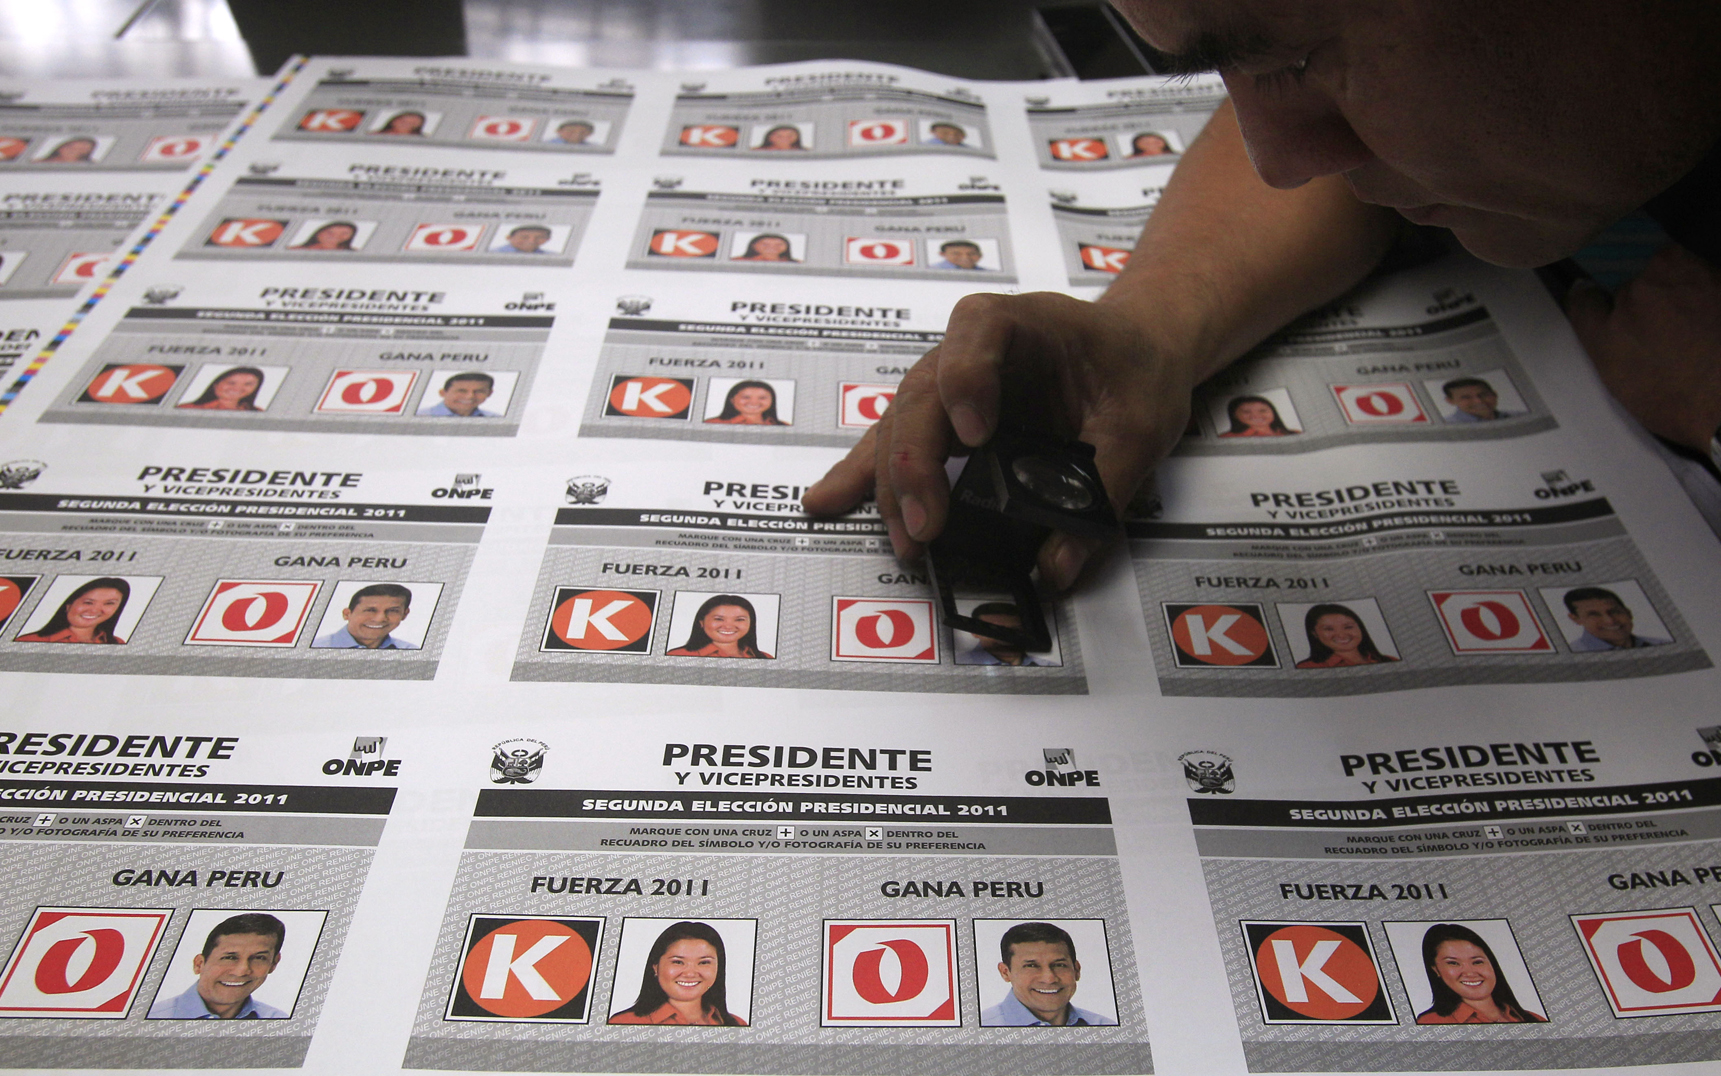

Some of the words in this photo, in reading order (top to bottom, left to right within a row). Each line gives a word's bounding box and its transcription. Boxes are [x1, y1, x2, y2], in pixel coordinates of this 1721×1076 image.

[310, 112, 356, 130] K
[689, 128, 727, 146] K
[1058, 140, 1097, 158] K
[219, 221, 271, 243] K
[660, 233, 706, 253] K
[1089, 246, 1130, 268] K
[259, 287, 446, 303] PRESIDENTE
[505, 302, 556, 311] ONPE
[731, 301, 911, 320] PRESIDENTE
[148, 345, 221, 355] FUERZA
[228, 346, 266, 356] 2011
[379, 352, 434, 361] GANA
[439, 353, 489, 362] PERU
[649, 356, 721, 368] FUERZA
[727, 360, 764, 369] 2011
[1414, 359, 1461, 374] PERU
[96, 370, 165, 398] K
[622, 381, 677, 412] K
[137, 466, 363, 488] PRESIDENTE
[143, 484, 156, 493] Y
[163, 485, 342, 499] VICEPRESIDENTES
[431, 487, 494, 500] ONPE
[703, 481, 810, 500] PRESI
[1250, 479, 1461, 508] PRESIDENTE
[1534, 480, 1596, 500] ONPE
[57, 499, 141, 511] SEGUNDA
[146, 501, 231, 514] ELECCIÓN
[234, 504, 358, 517] PRESIDENCIAL
[363, 508, 406, 518] 2011
[713, 499, 725, 508] Y
[1267, 510, 1279, 519] Y
[1285, 498, 1455, 519] VICEPRESIDENTES
[639, 513, 721, 526] SEGUNDA
[727, 517, 808, 530] ELECCIÓN
[1206, 527, 1285, 537] SEGUNDA
[1289, 521, 1369, 537] ELECCIÓN
[1372, 514, 1488, 528] PRESIDENCIAL
[1491, 513, 1532, 523] 2011
[655, 539, 709, 548] RECUADRO
[678, 532, 720, 541] MARQUE
[87, 551, 138, 562] 2011
[274, 556, 340, 567] GANA
[347, 557, 409, 569] PERU
[601, 562, 690, 577] FUERZA
[697, 567, 742, 579] 2011
[1459, 564, 1523, 576] GANA
[1527, 560, 1583, 575] PERU
[877, 573, 935, 585] GAN
[1195, 576, 1281, 589] FUERZA
[1285, 577, 1329, 589] 2011
[566, 598, 635, 641] K
[1185, 615, 1254, 655] K
[662, 743, 932, 772] PRESIDENTE
[1340, 740, 1601, 777] PRESIDENTE
[322, 759, 402, 777] ONPE
[675, 772, 691, 785] Y
[699, 772, 918, 789] VICEPRESIDENTES
[1025, 770, 1100, 787] ONPE
[1362, 781, 1377, 794] Y
[1385, 768, 1595, 792] VICEPRESIDENTES
[70, 789, 227, 804] PRESIDENCIAL
[233, 793, 288, 805] 2011
[1289, 808, 1387, 821] SEGUNDA
[1391, 799, 1490, 818] ELECCIÓN
[1494, 794, 1639, 812] PRESIDENCIAL
[1642, 789, 1694, 804] 2011
[582, 799, 684, 812] SEGUNDA
[691, 798, 794, 813] ELECCIÓN
[800, 802, 951, 816] PRESIDENCIAL
[957, 805, 1008, 816] 2011
[0, 816, 32, 824] CRUZ
[58, 817, 68, 825] O
[72, 817, 90, 825] UN
[92, 817, 123, 825] ASPA
[148, 818, 197, 827] DENTRO
[9, 827, 33, 836] Y/O
[36, 828, 119, 837] FOTOGRAFÍA
[121, 829, 139, 838] DE
[141, 830, 158, 838] SU
[161, 830, 245, 839] PREFERENCIA
[629, 827, 682, 836] MARQUE
[684, 828, 711, 836] CON
[713, 829, 739, 837] UNA
[742, 829, 772, 837] CRUZ
[832, 830, 863, 838] ASPA
[886, 830, 933, 838] DENTRO
[937, 831, 959, 839] DEL
[1346, 835, 1396, 844] MARQUE
[1398, 834, 1422, 843] CON
[1424, 833, 1450, 841] UNA
[1452, 830, 1482, 839] CRUZ
[1506, 828, 1516, 836] O
[1518, 827, 1536, 835] UN
[1538, 825, 1567, 834] ASPA
[1587, 822, 1633, 831] DENTRO
[1636, 820, 1657, 828] DEL
[600, 839, 668, 847] RECUADRO
[671, 839, 695, 848] DEL
[698, 838, 754, 848] SÍMBOLO
[758, 840, 781, 849] Y/O
[784, 839, 863, 849] FOTOGRAFÍA
[867, 841, 883, 849] DE
[886, 841, 902, 849] SU
[905, 842, 986, 850] PREFERENCIA
[1324, 846, 1388, 855] RECUADRO
[1391, 845, 1414, 854] DEL
[1416, 842, 1470, 853] SÍMBOLO
[1472, 841, 1494, 850] Y/O
[1497, 836, 1573, 849] FOTOGRAFÍA
[1575, 835, 1591, 844] DE
[1593, 834, 1609, 843] SU
[1611, 829, 1689, 842] PREFERENCIA
[112, 869, 197, 887] GANA
[205, 870, 286, 889] PERU
[531, 876, 643, 895] FUERZA
[651, 879, 709, 896] 2011
[1607, 869, 1692, 891] GANA
[881, 881, 966, 898] GANA
[973, 881, 1044, 898] PERU
[1279, 883, 1387, 901] FUERZA
[1391, 883, 1449, 900] 2011
[480, 934, 571, 1001] K
[1271, 939, 1364, 1003] K
